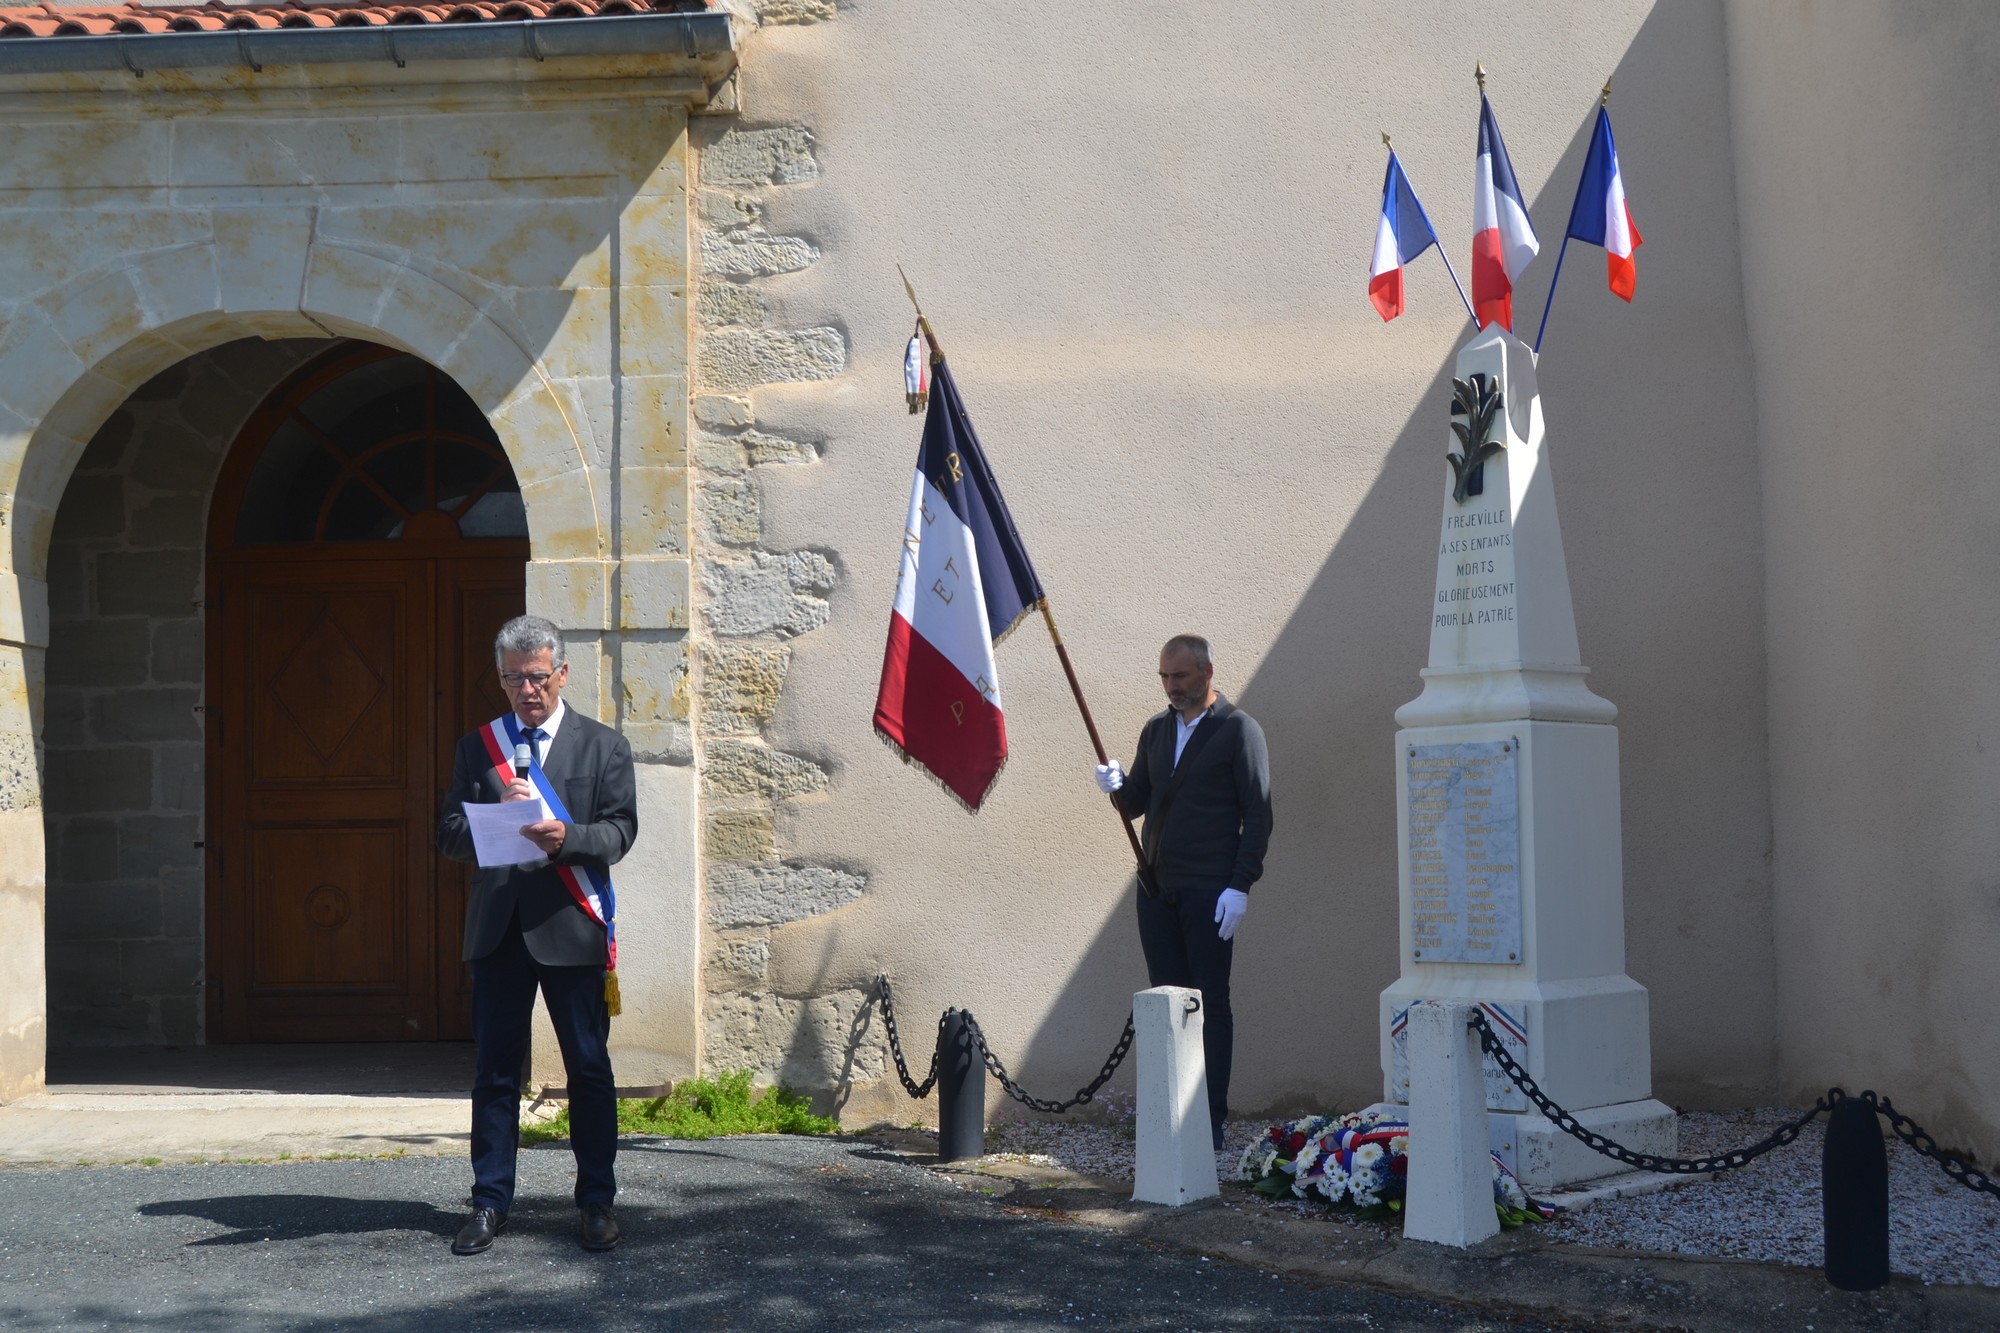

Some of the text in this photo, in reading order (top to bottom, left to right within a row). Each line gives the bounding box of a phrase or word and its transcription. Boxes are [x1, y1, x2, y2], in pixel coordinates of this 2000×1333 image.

[1447, 509, 1505, 529] FREJEVILLE
[1441, 534, 1511, 555] A SES ENFANTS
[1456, 560, 1494, 577] MORTS
[931, 557, 960, 606] ET
[1438, 582, 1514, 603] GLORIEUSEMENT
[1435, 606, 1514, 628] POUR LA PATRIE
[950, 674, 997, 727] PA
[1482, 1068, 1506, 1079] parus
